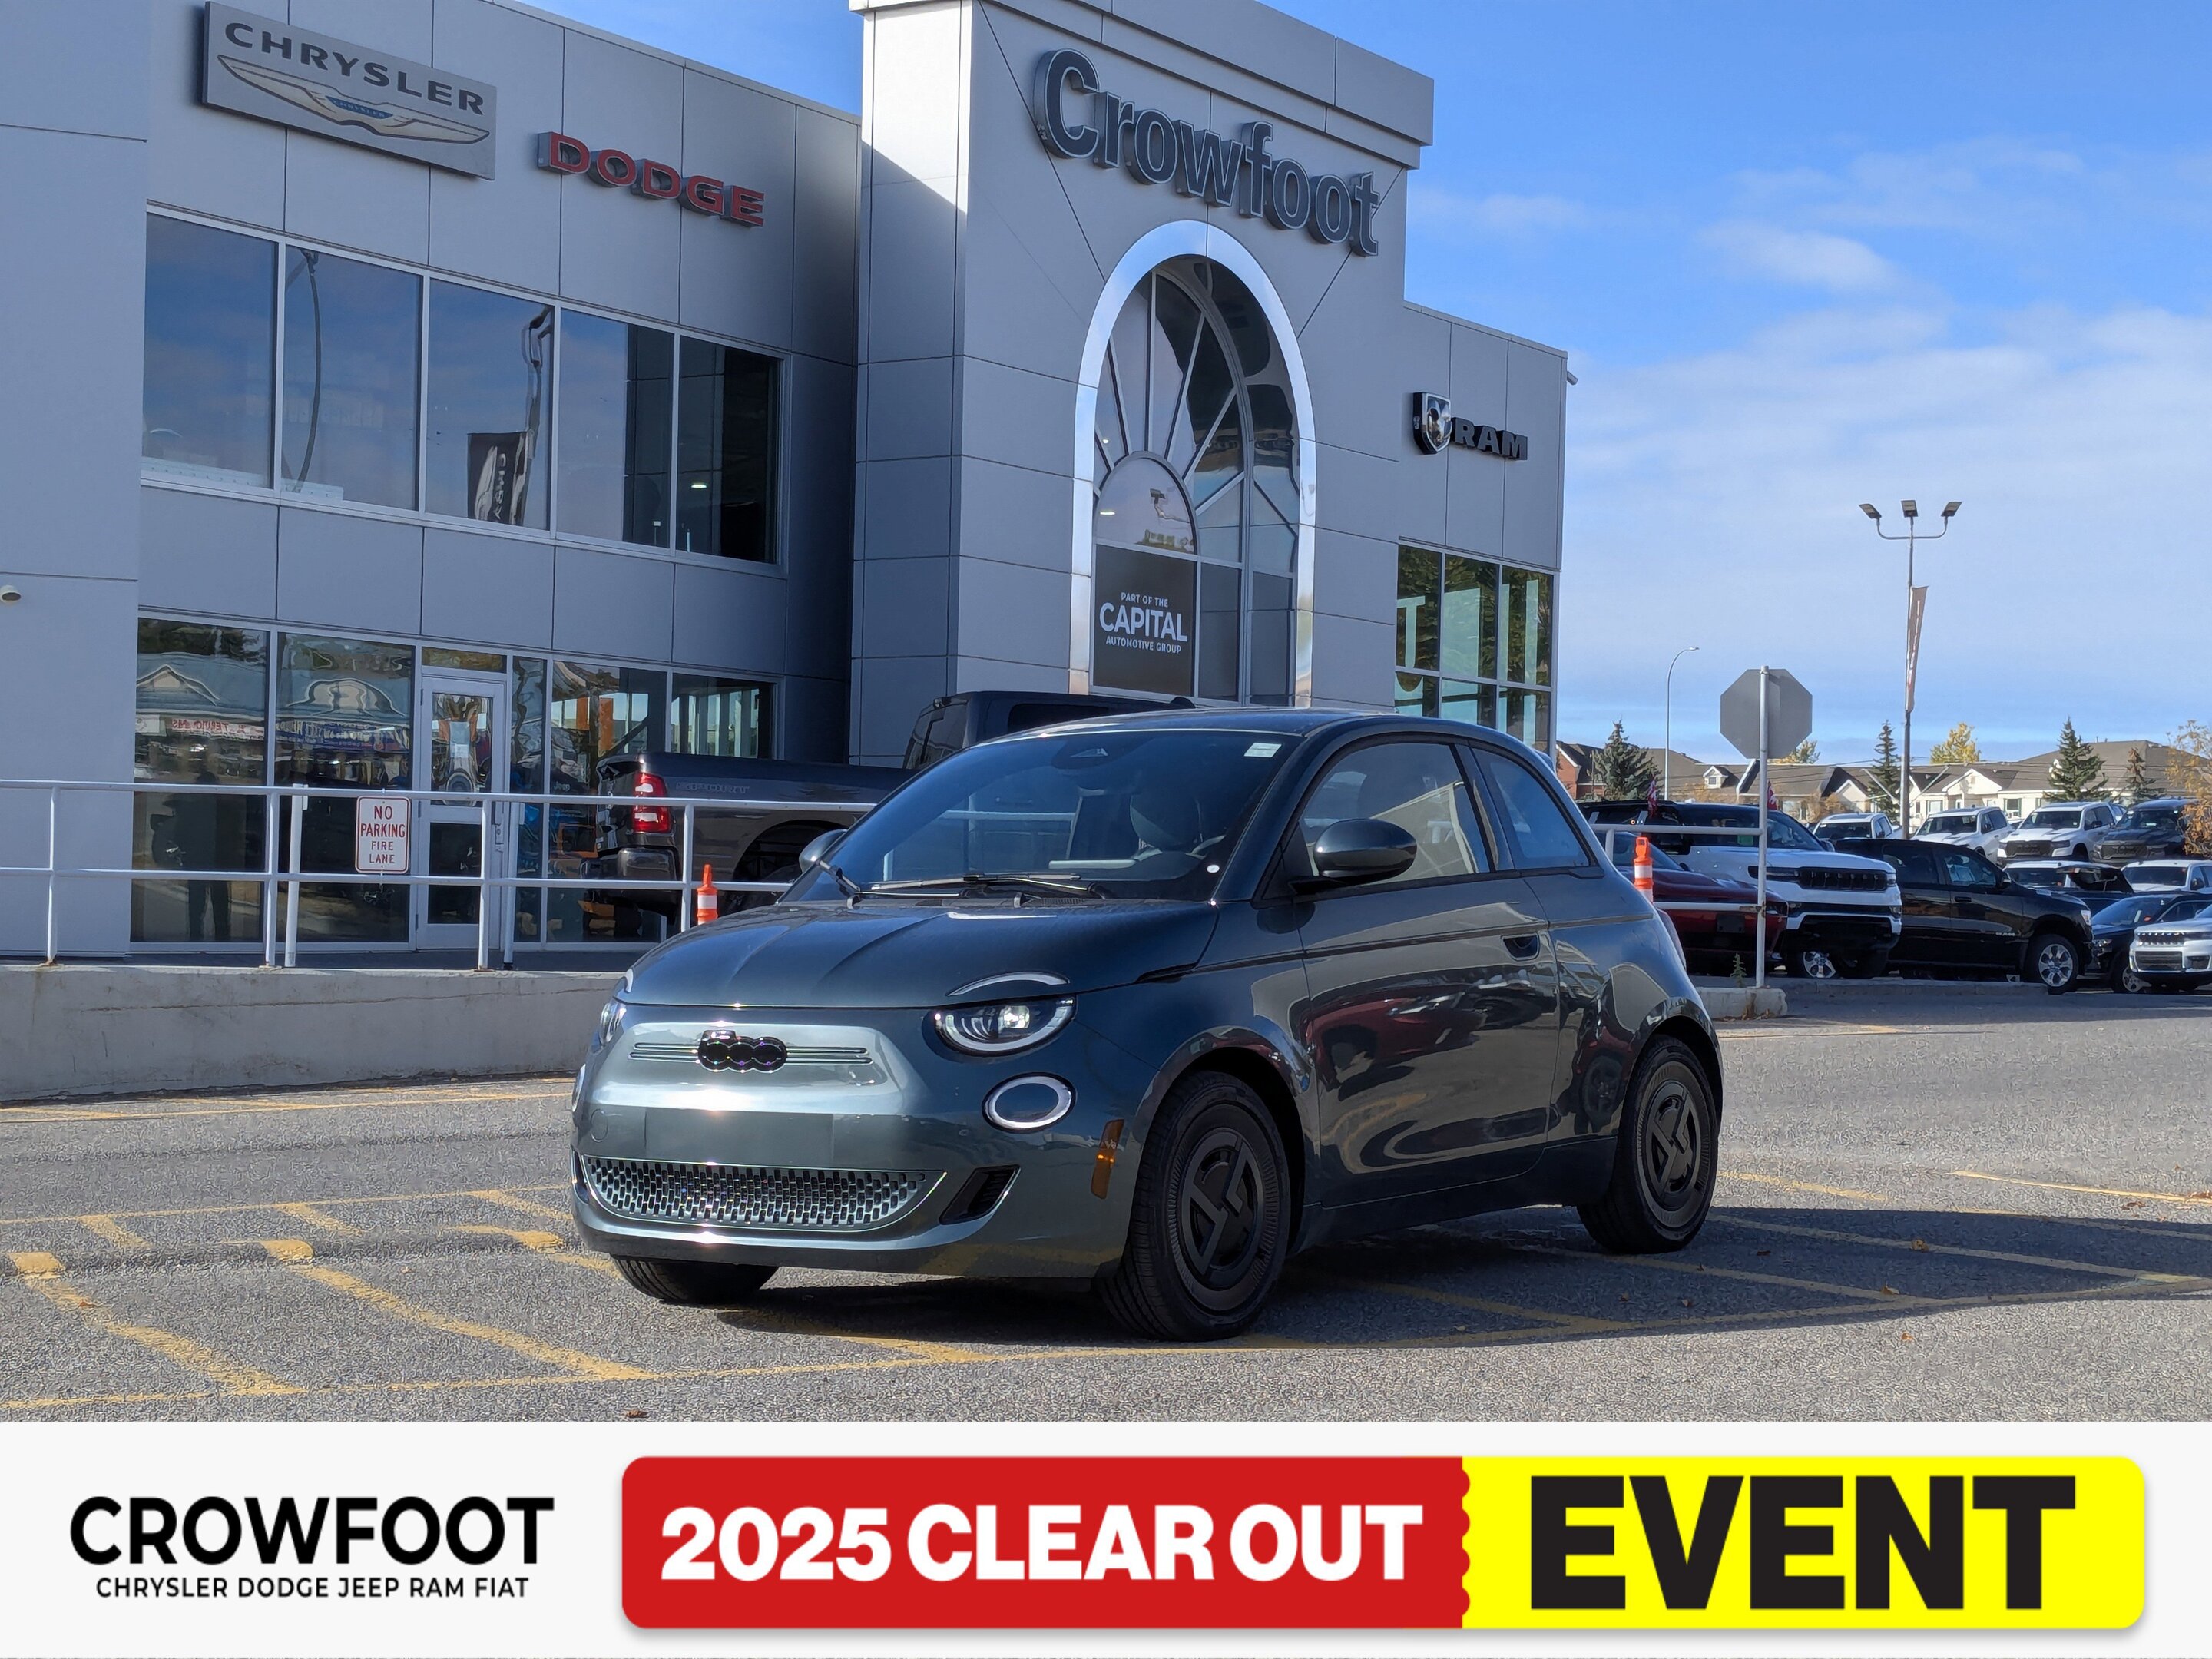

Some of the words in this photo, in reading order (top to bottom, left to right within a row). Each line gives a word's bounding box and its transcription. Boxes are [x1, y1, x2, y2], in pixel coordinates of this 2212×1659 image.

[225, 22, 485, 117] CHRYSLER
[1035, 48, 1381, 257] Crowfoot
[541, 131, 765, 228] DODGE
[1451, 417, 1528, 460] RAM
[1121, 592, 1141, 603] PART
[1142, 595, 1153, 604] OF
[1154, 597, 1168, 608] THE
[1099, 602, 1188, 642] CAPITAL
[1106, 636, 1154, 651] AUTOMOTIVE
[1156, 642, 1181, 654] GROUP
[374, 805, 393, 820] NO
[360, 823, 406, 838] PARKING
[371, 841, 394, 851] FIRE
[369, 853, 396, 864] LANE
